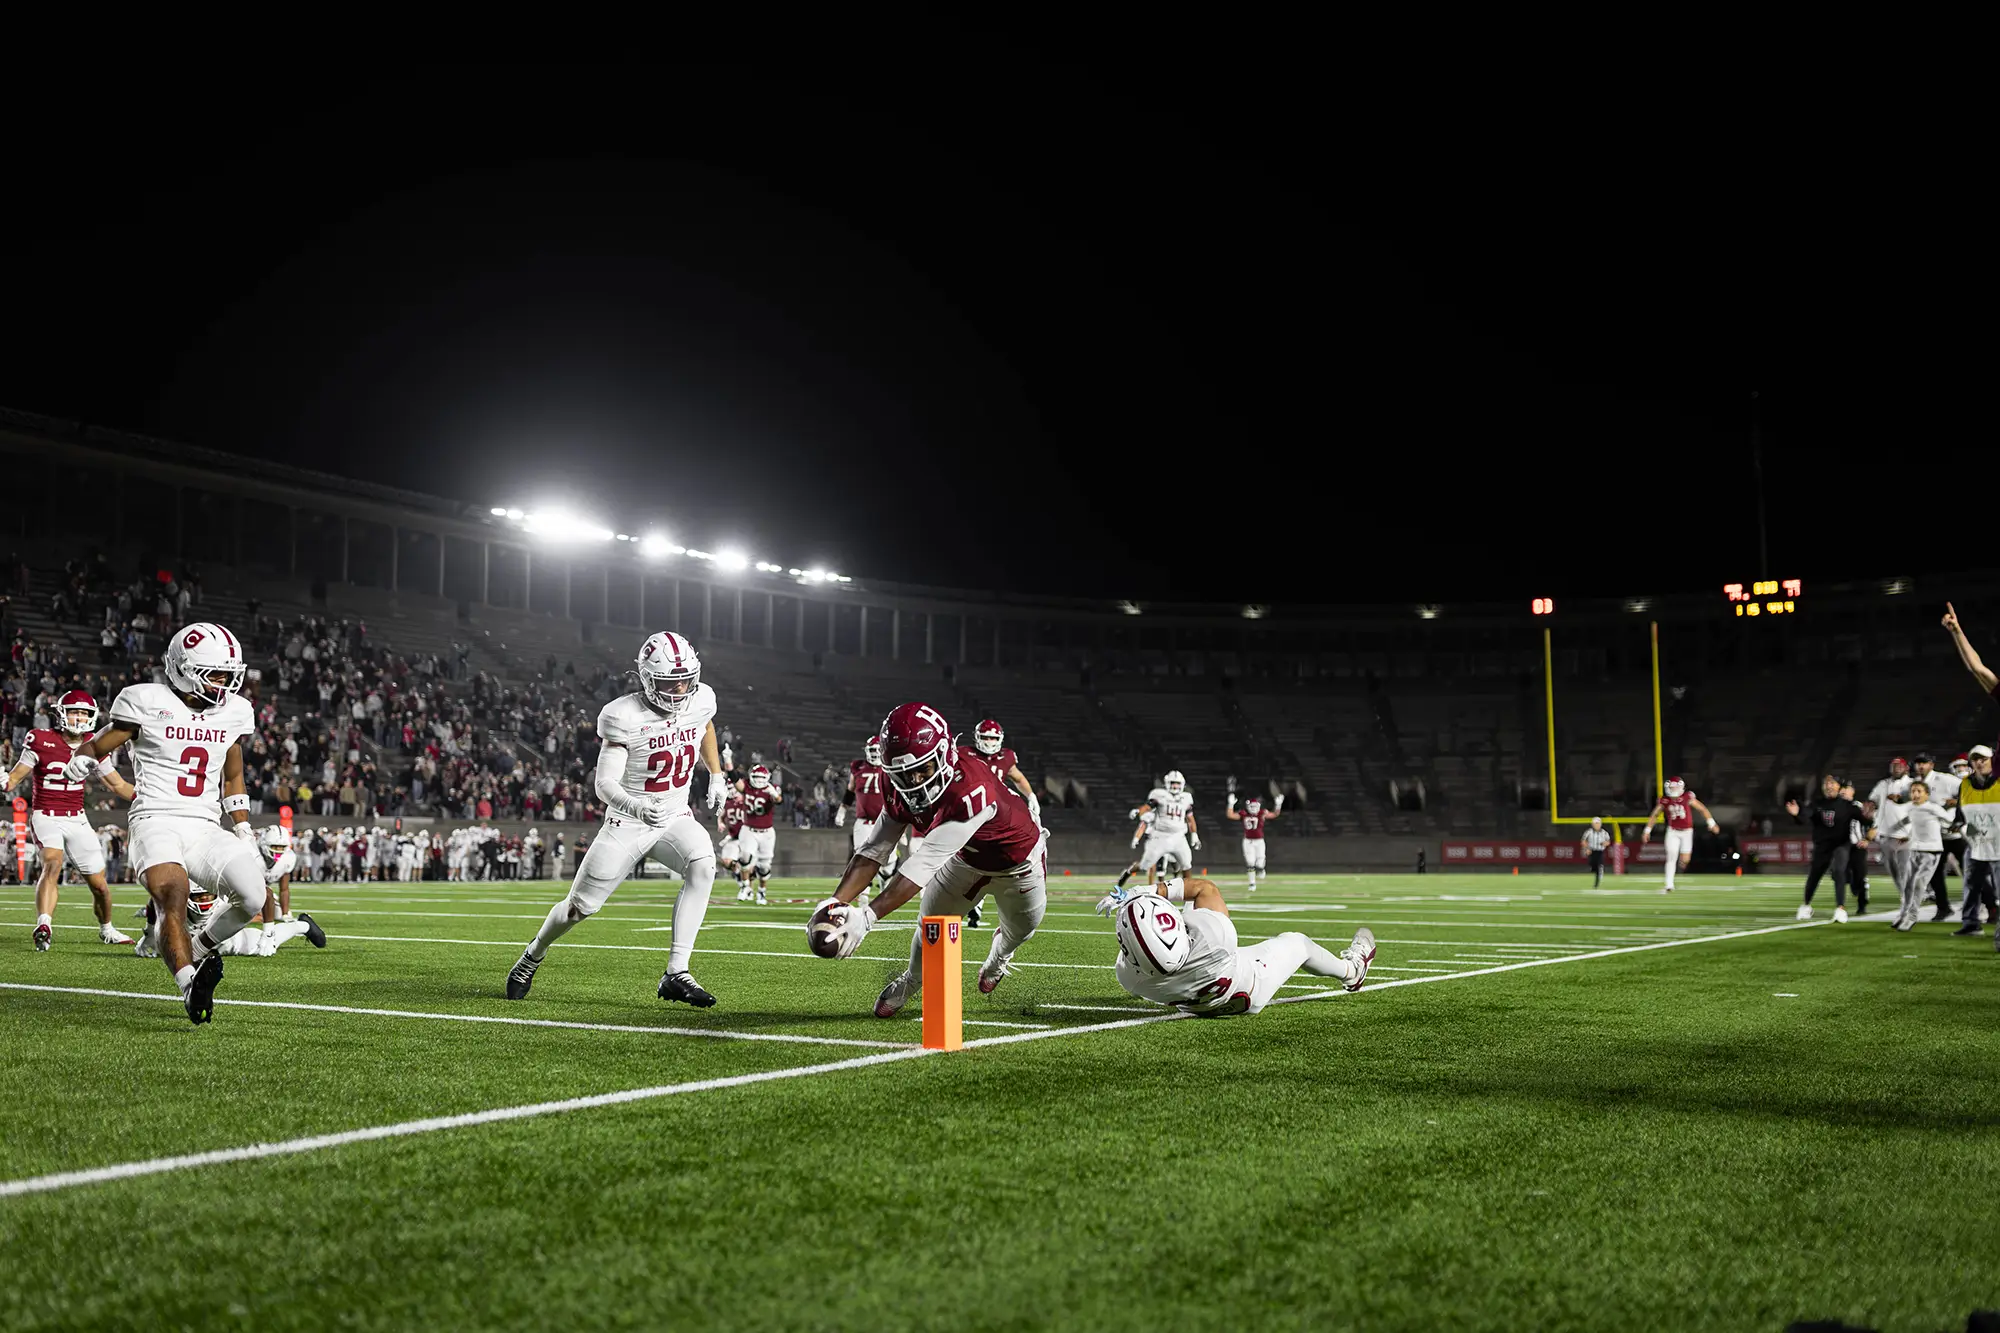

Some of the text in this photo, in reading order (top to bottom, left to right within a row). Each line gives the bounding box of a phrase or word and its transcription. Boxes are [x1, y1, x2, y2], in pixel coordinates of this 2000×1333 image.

[186, 633, 200, 646] C
[915, 705, 945, 735] H
[165, 726, 227, 743] COLGATE
[177, 746, 209, 797] 3
[644, 744, 696, 793] 20
[861, 772, 881, 794] 71
[744, 797, 766, 816] 56
[962, 784, 987, 819] 17
[1166, 804, 1183, 820] 44
[928, 924, 938, 939] H
[950, 924, 958, 938] H
